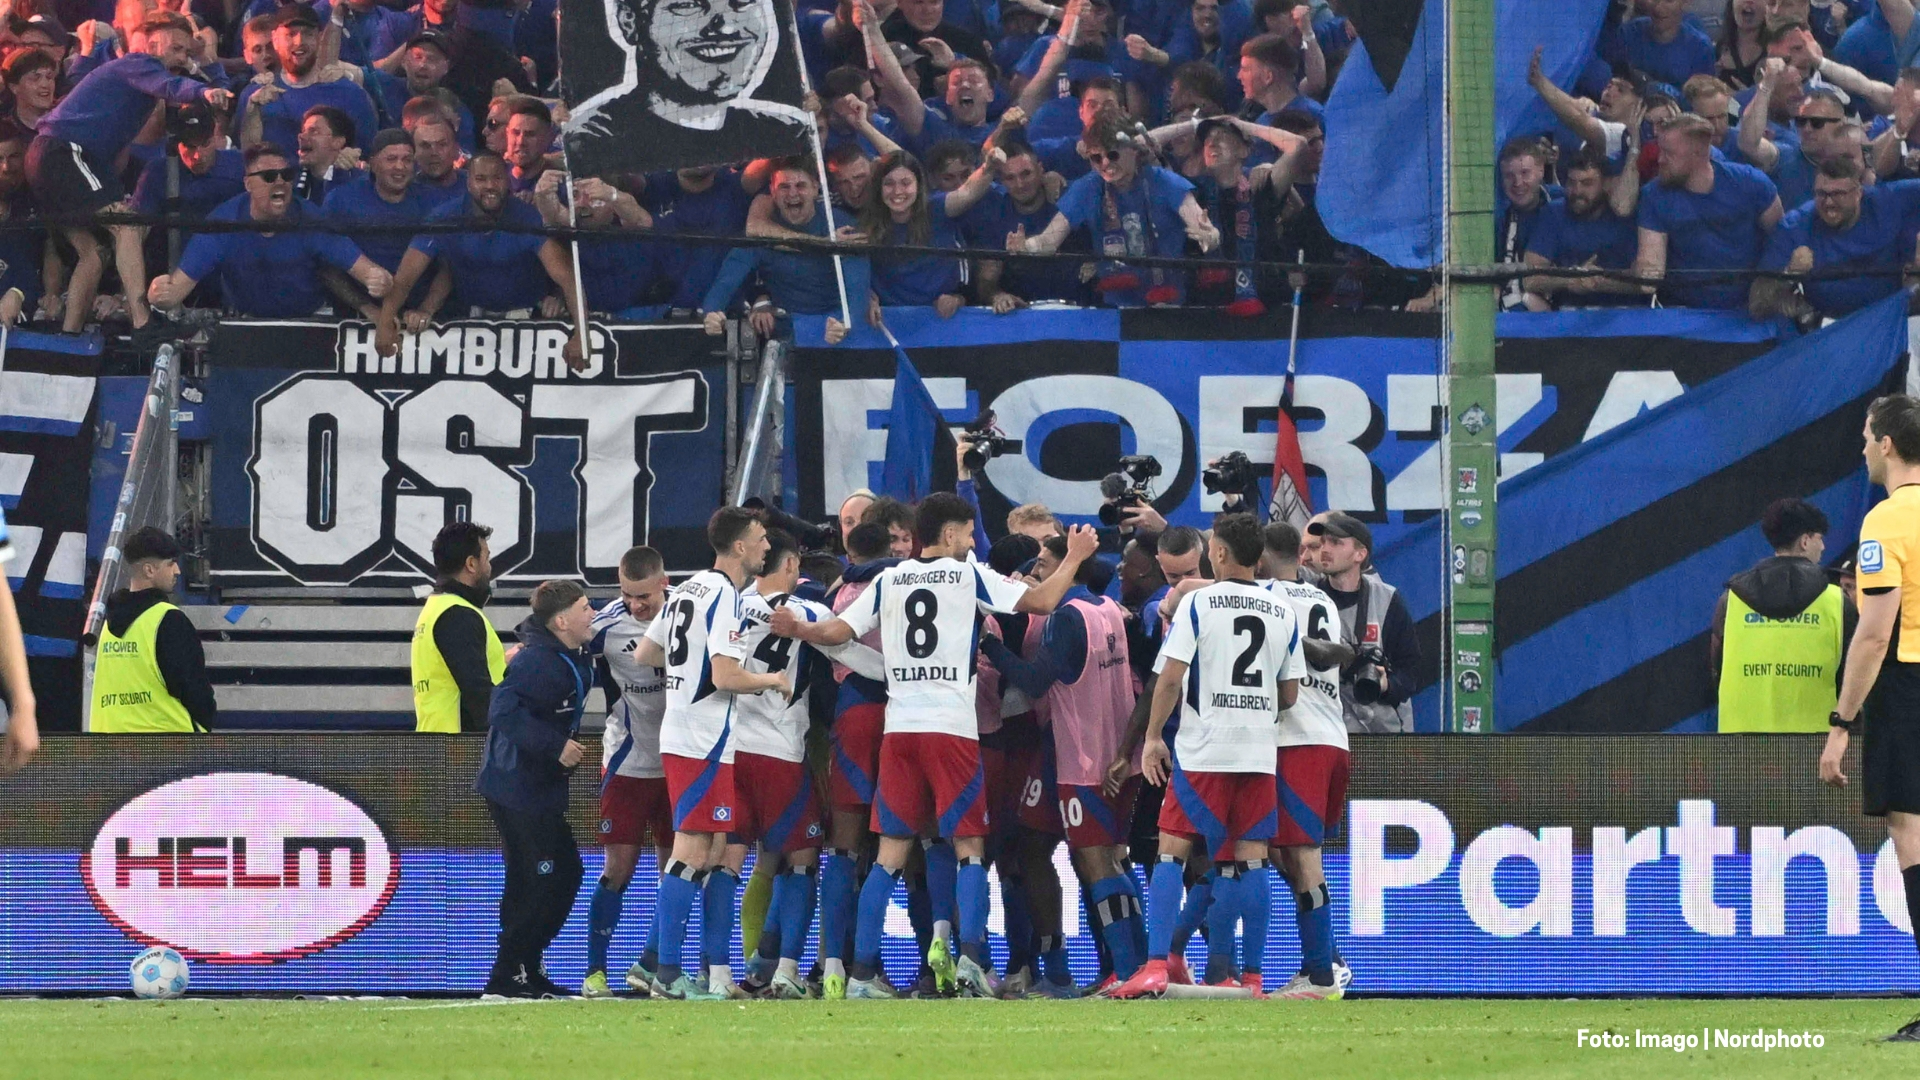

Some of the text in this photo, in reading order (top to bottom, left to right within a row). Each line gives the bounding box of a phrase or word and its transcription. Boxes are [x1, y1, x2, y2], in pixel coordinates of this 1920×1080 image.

[254, 378, 695, 569] OST
[892, 570, 962, 586] HMBURGER SV
[905, 588, 938, 659] 8
[1208, 595, 1273, 616] HAMBURGER
[1274, 605, 1286, 619] SV
[752, 632, 794, 673] 4
[1231, 614, 1266, 688] 2
[1743, 663, 1823, 678] EVENT SECURITY
